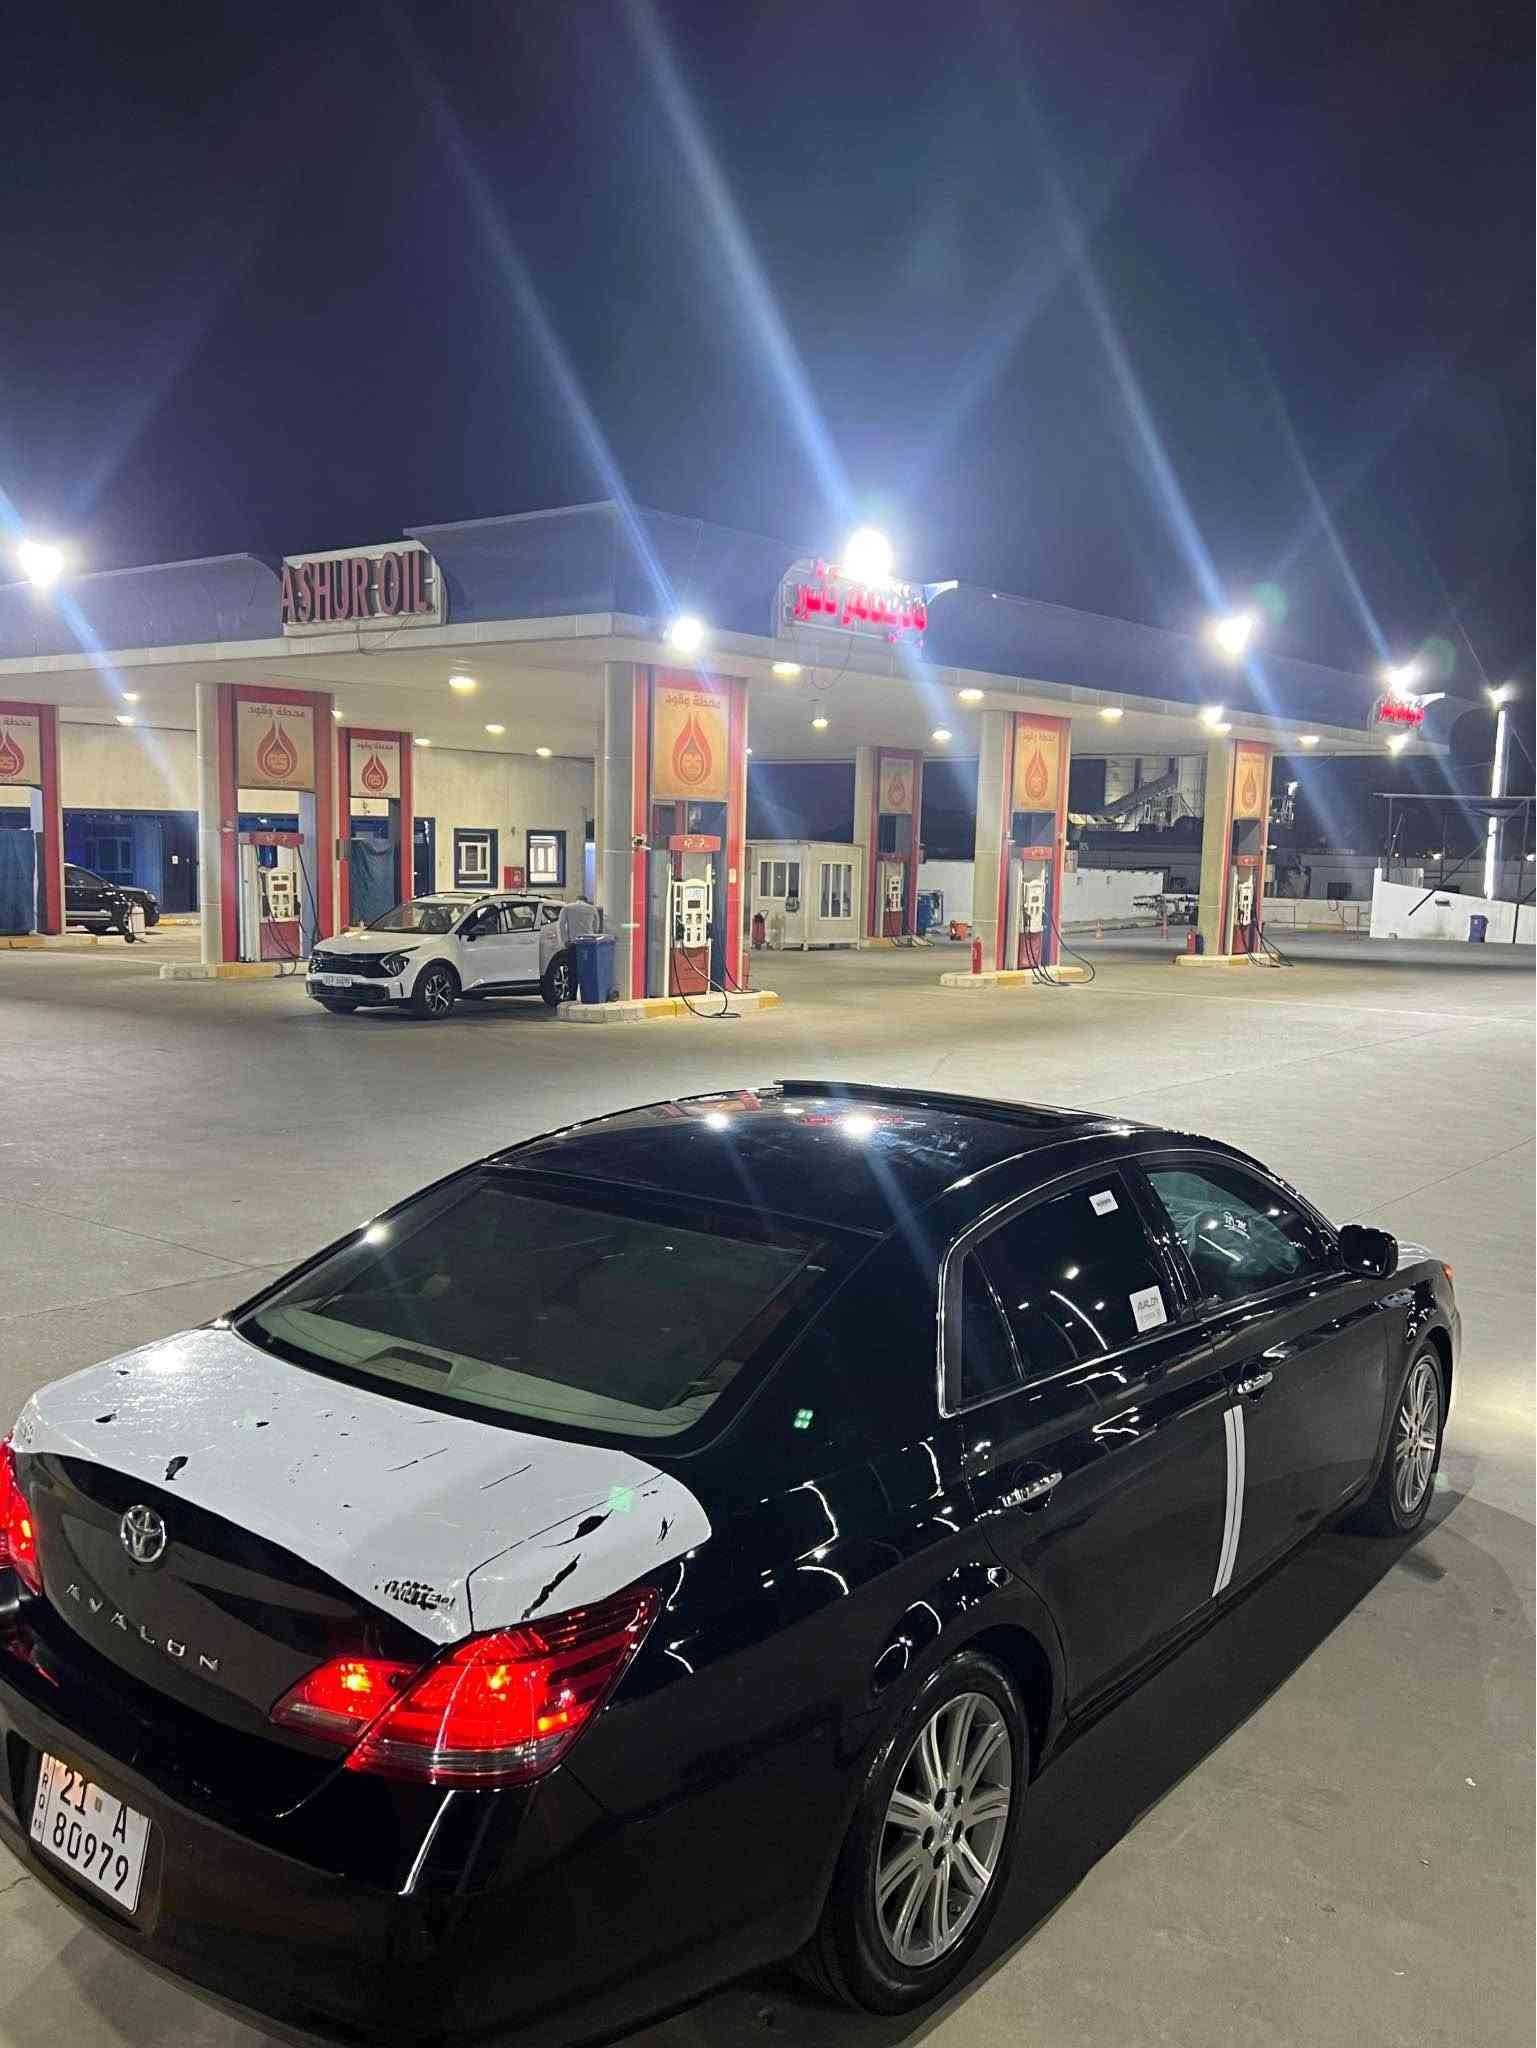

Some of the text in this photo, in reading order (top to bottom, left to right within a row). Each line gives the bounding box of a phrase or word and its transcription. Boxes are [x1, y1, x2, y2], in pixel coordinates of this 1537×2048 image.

[281, 549, 432, 624] ASHUR OIL
[66, 1584, 219, 1672] AVALON
[60, 1769, 128, 1844] 21 A
[53, 1811, 129, 1892] 80979
